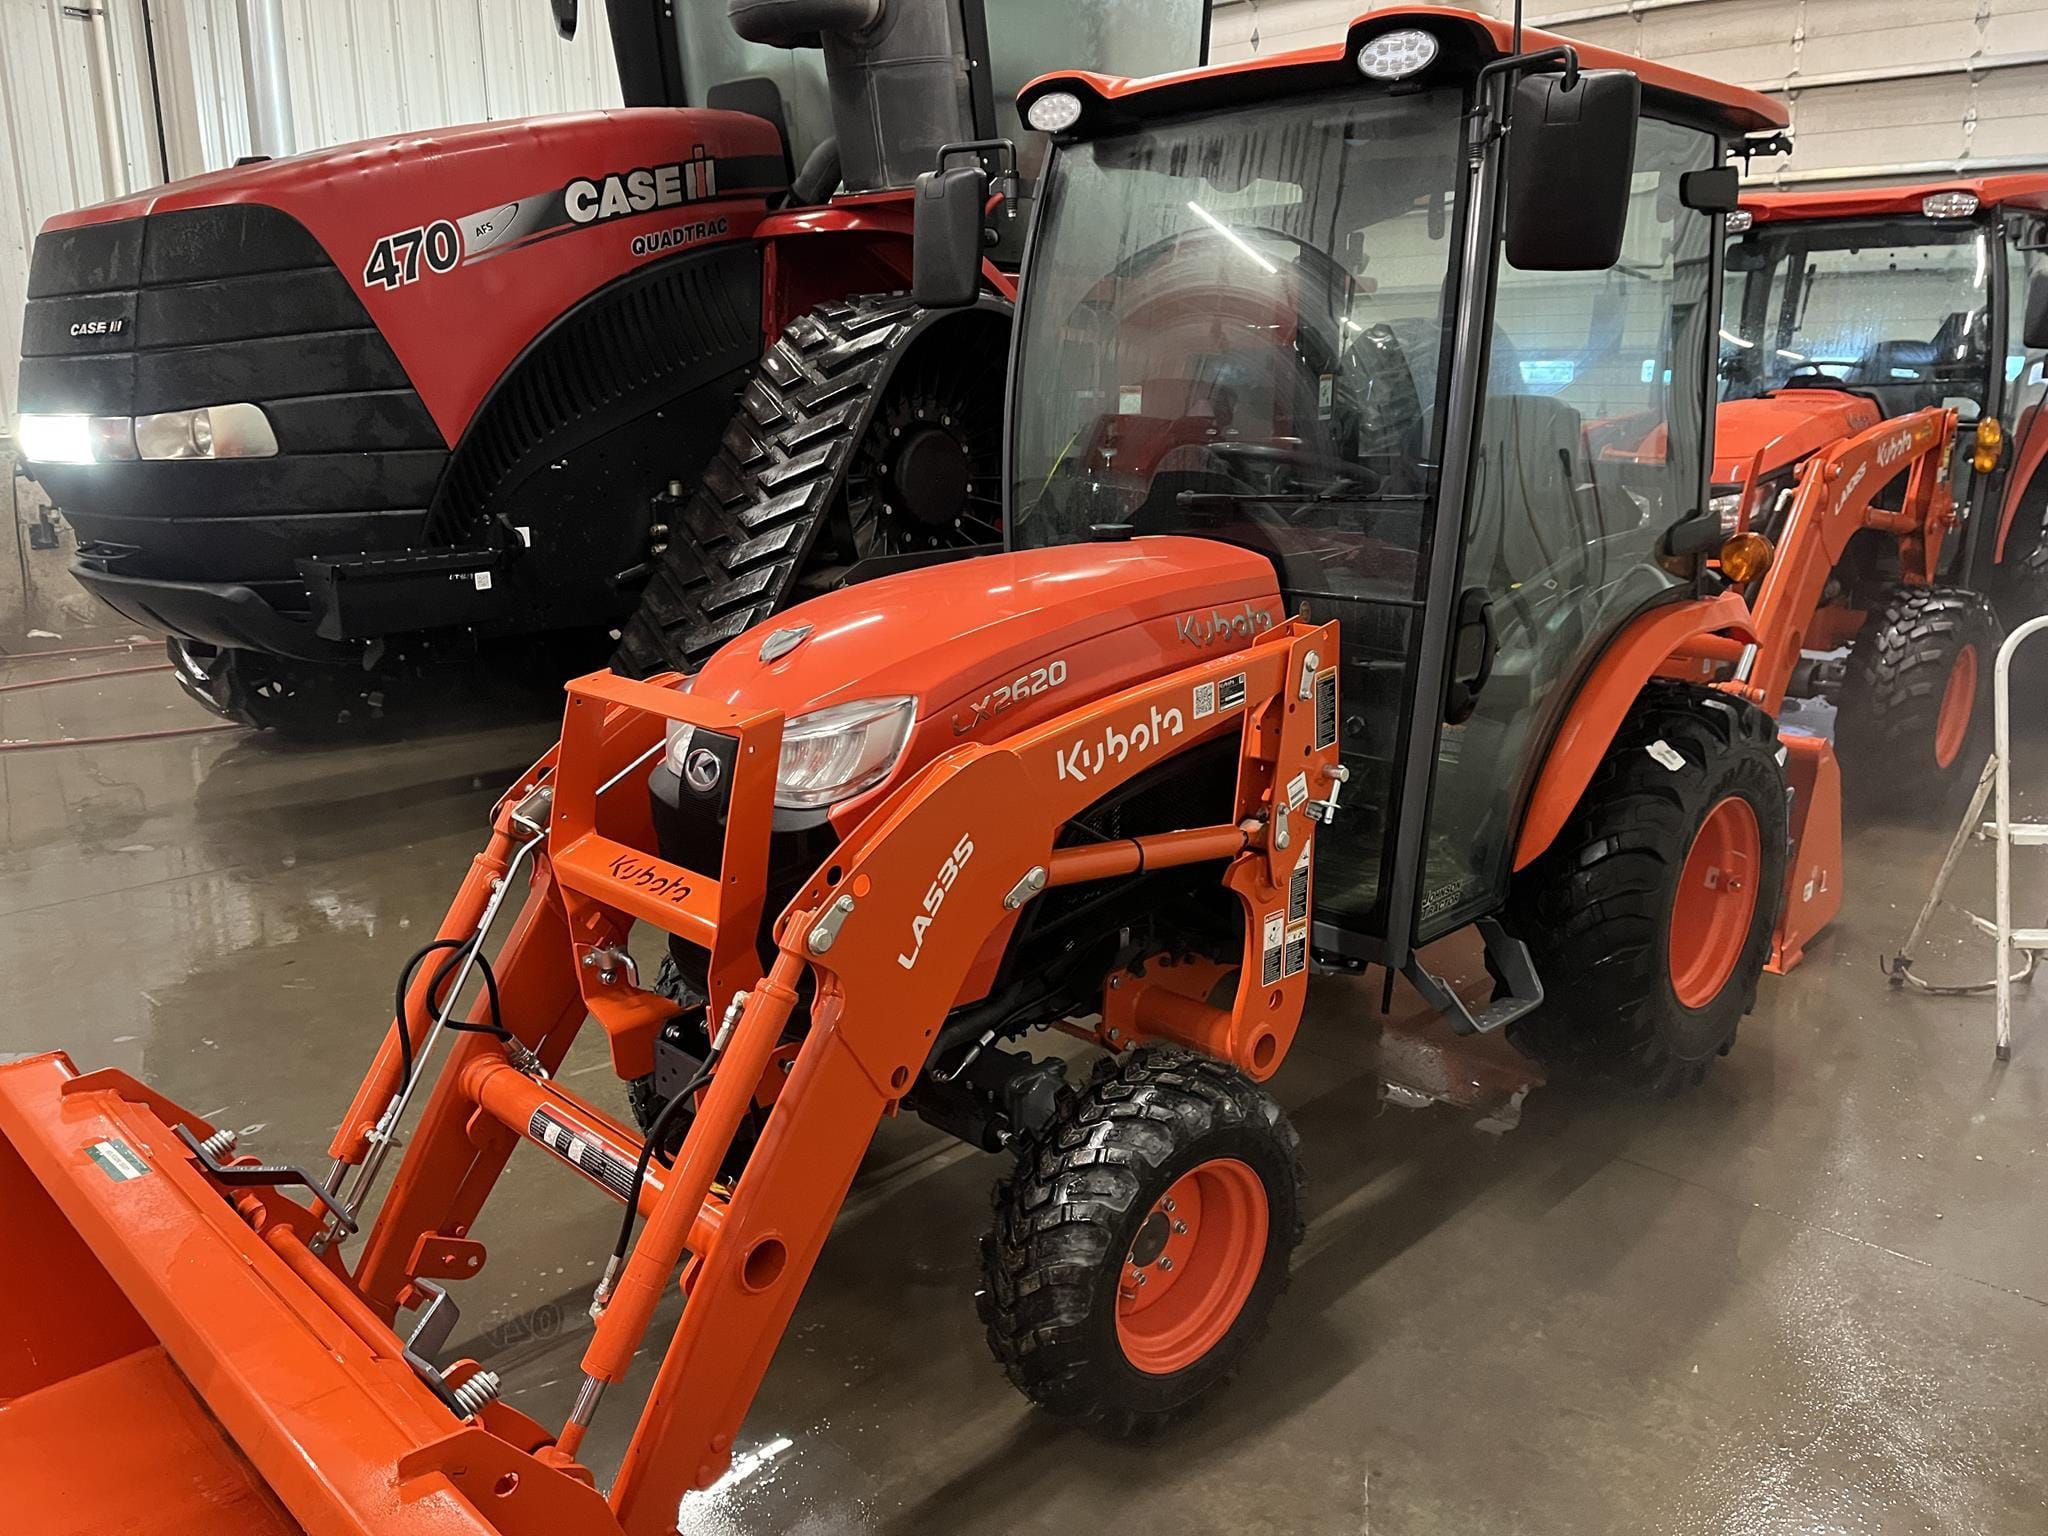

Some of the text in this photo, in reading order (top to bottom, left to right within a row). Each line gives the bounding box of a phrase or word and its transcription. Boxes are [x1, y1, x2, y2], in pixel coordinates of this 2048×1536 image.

[565, 164, 682, 223] CASE
[363, 219, 461, 291] 470
[475, 222, 494, 238] AFS
[631, 216, 728, 257] QUADTRAC
[70, 321, 107, 336] CASE
[1175, 602, 1273, 647] Kubota
[951, 659, 1067, 737] LX2620
[1056, 705, 1184, 782] Kubota
[608, 854, 692, 903] Kubota
[897, 832, 974, 970] LA535
